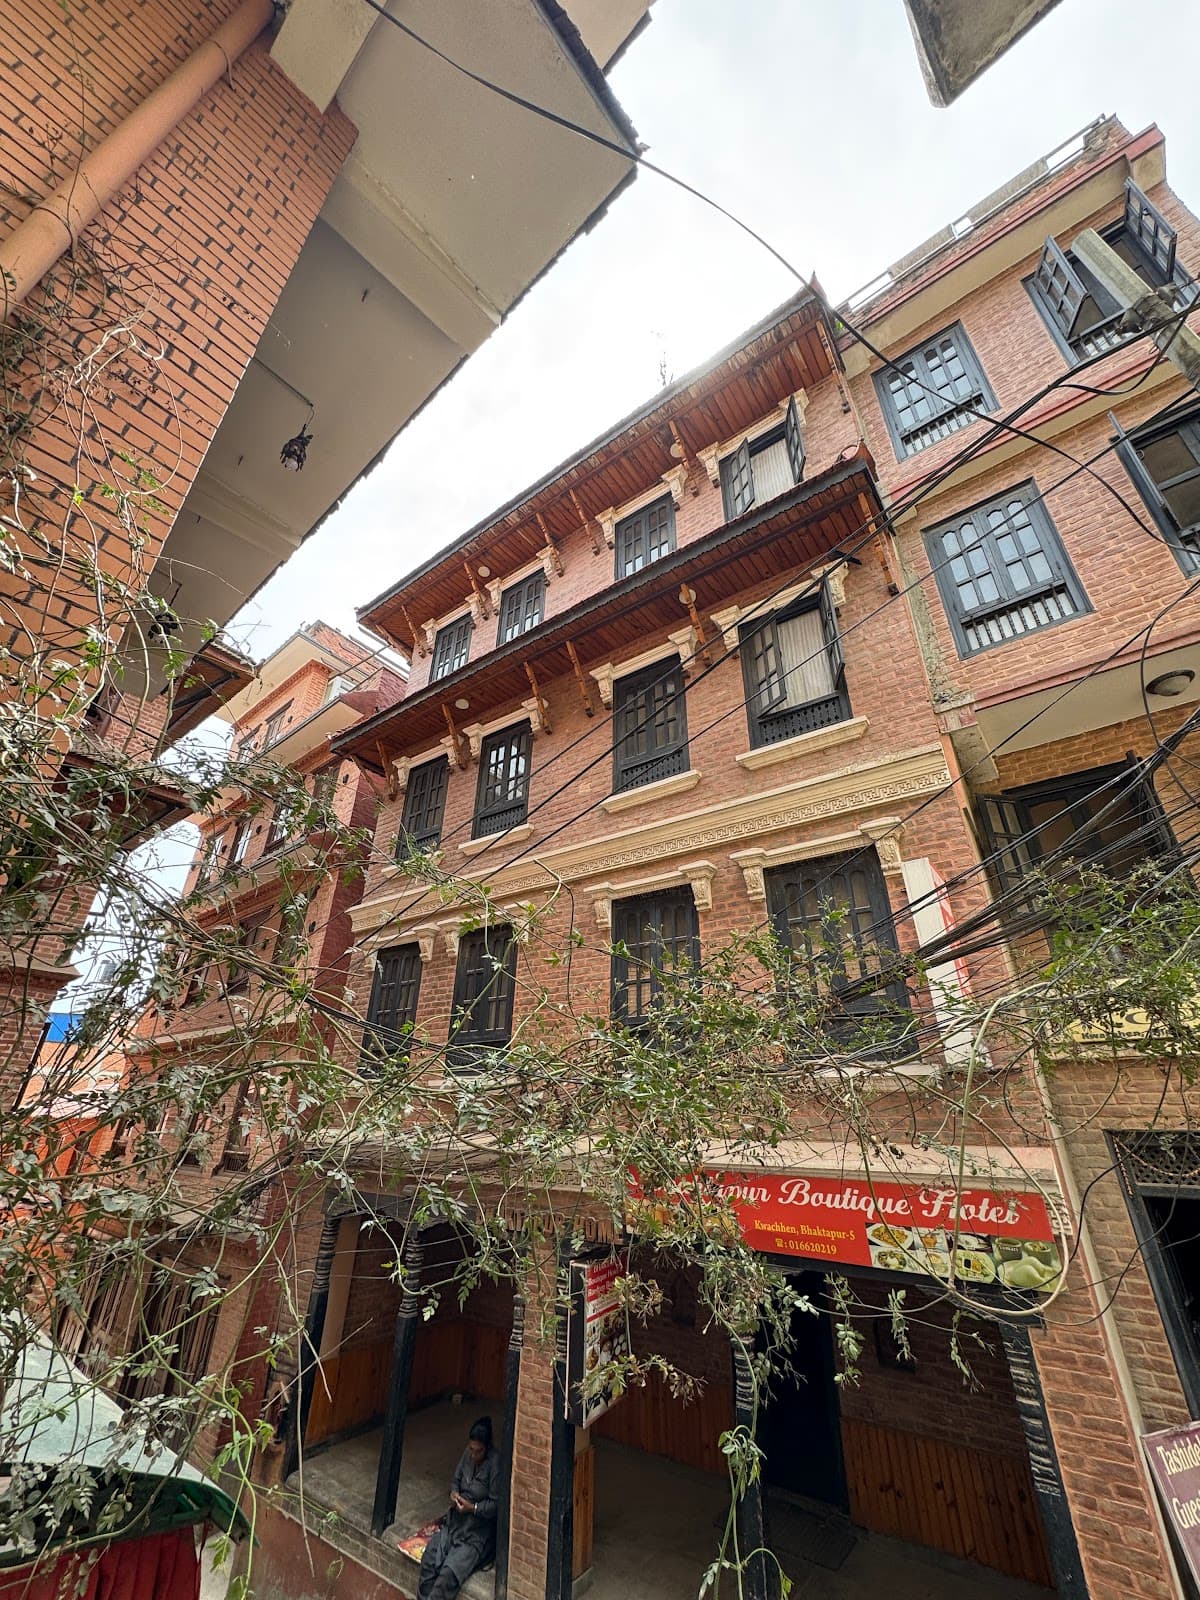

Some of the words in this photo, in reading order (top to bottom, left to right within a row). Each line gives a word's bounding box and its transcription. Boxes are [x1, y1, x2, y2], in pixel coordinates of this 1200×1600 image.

[779, 1178, 913, 1220] Boutique
[919, 1188, 1020, 1225] Hotel
[754, 1219, 799, 1235] Kwachhen,
